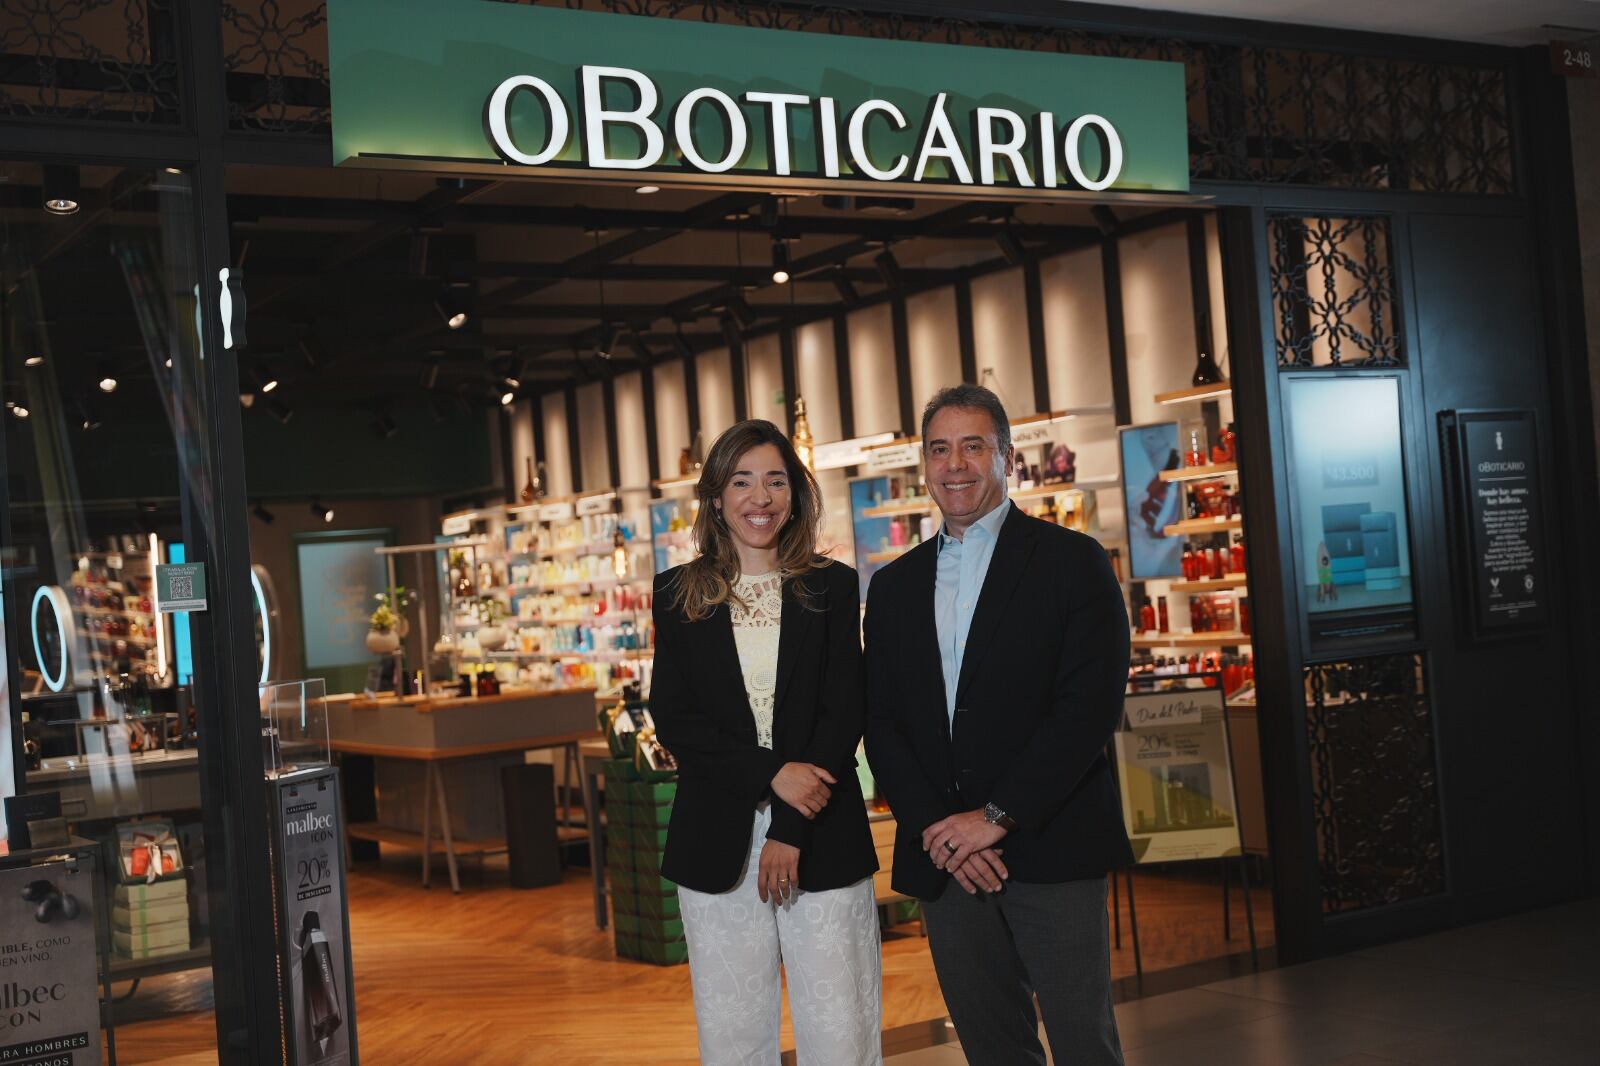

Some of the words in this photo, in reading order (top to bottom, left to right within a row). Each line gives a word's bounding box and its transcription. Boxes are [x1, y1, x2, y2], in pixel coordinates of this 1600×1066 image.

[1563, 49, 1592, 68] 2-48
[287, 811, 333, 835] malbec
[0, 942, 33, 954] IBLE,
[36, 936, 71, 949] COMO
[0, 957, 18, 967] EN
[0, 982, 66, 1010] lbec
[0, 1048, 20, 1060] RA
[25, 1036, 86, 1056] HOMBRES
